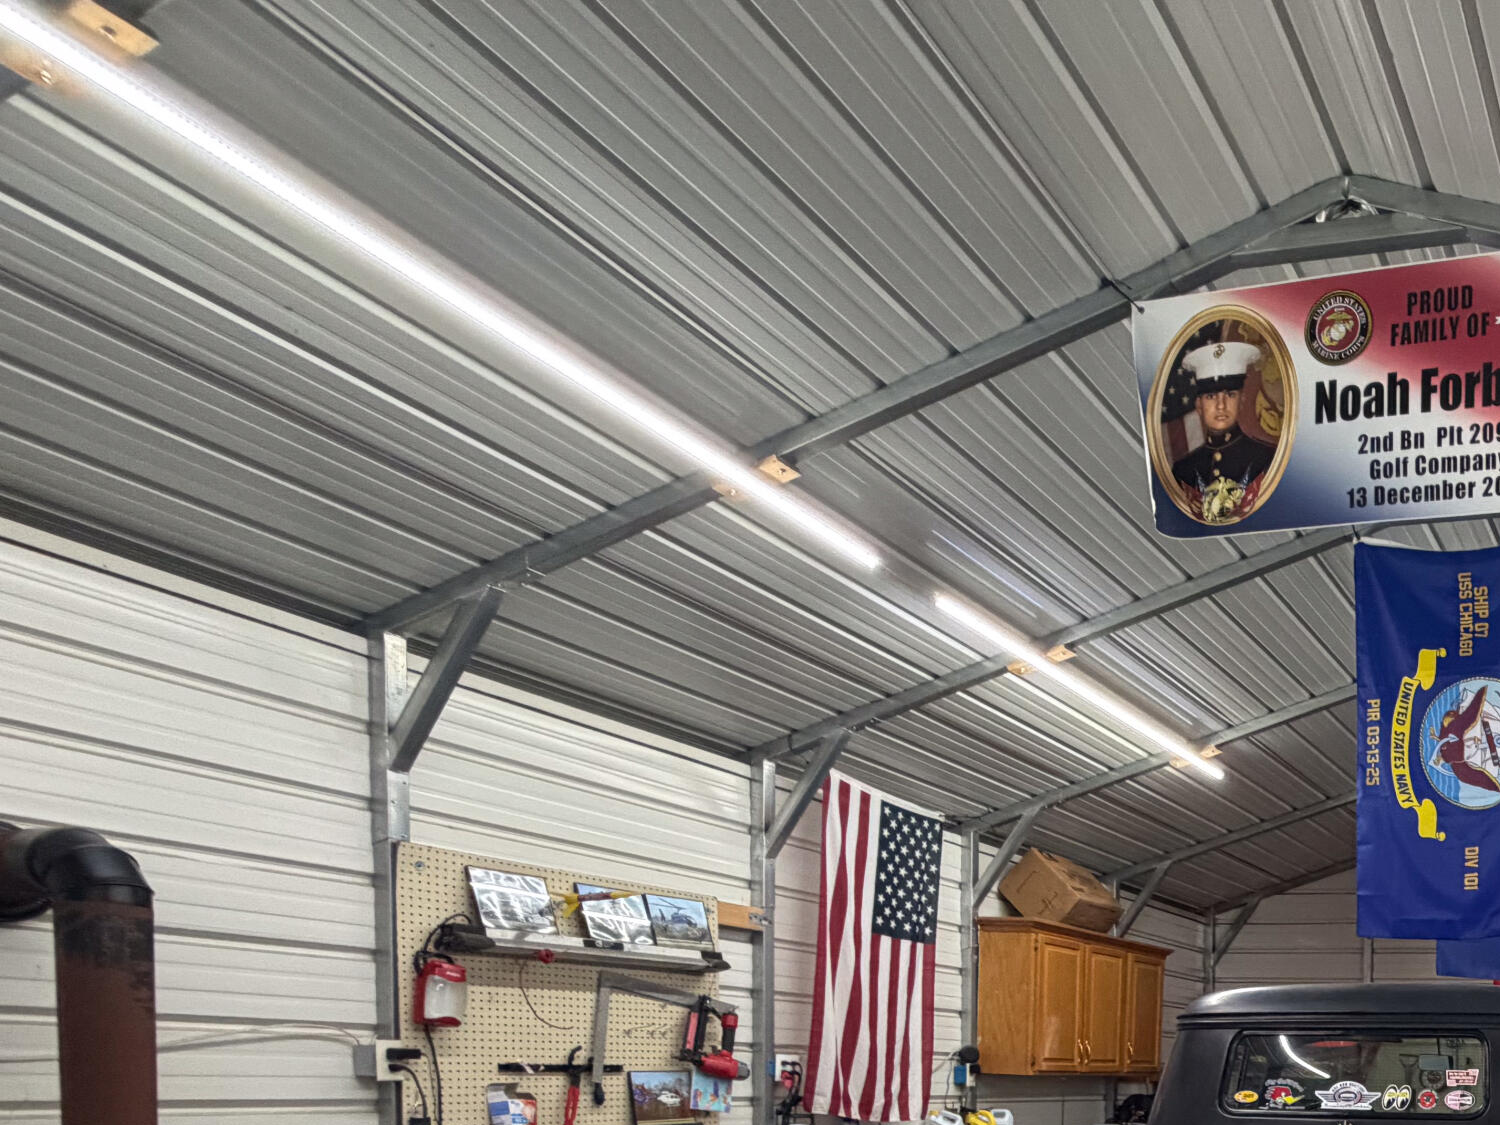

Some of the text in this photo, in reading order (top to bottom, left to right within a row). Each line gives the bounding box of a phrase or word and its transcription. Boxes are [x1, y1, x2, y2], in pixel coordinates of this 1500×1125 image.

[1313, 296, 1367, 325] UNITED STATES
[1407, 285, 1473, 316] PROUD
[1390, 312, 1490, 346] FAMILY OF
[1311, 335, 1366, 360] MARINE CORPS
[1315, 372, 1410, 424] Noah
[1358, 431, 1394, 454] 2nd
[1401, 430, 1425, 450] Bn
[1436, 425, 1463, 447] Plt
[1370, 454, 1409, 480] Golf
[1347, 487, 1367, 508] 13
[1374, 480, 1476, 506] December
[1457, 572, 1473, 656] USS CHICAGO
[1474, 586, 1489, 638] SHIP 07
[1366, 699, 1380, 786] PIR 03-13-25
[1393, 682, 1414, 803] UNITED STATES NAVY
[1463, 846, 1479, 891] DIV 101
